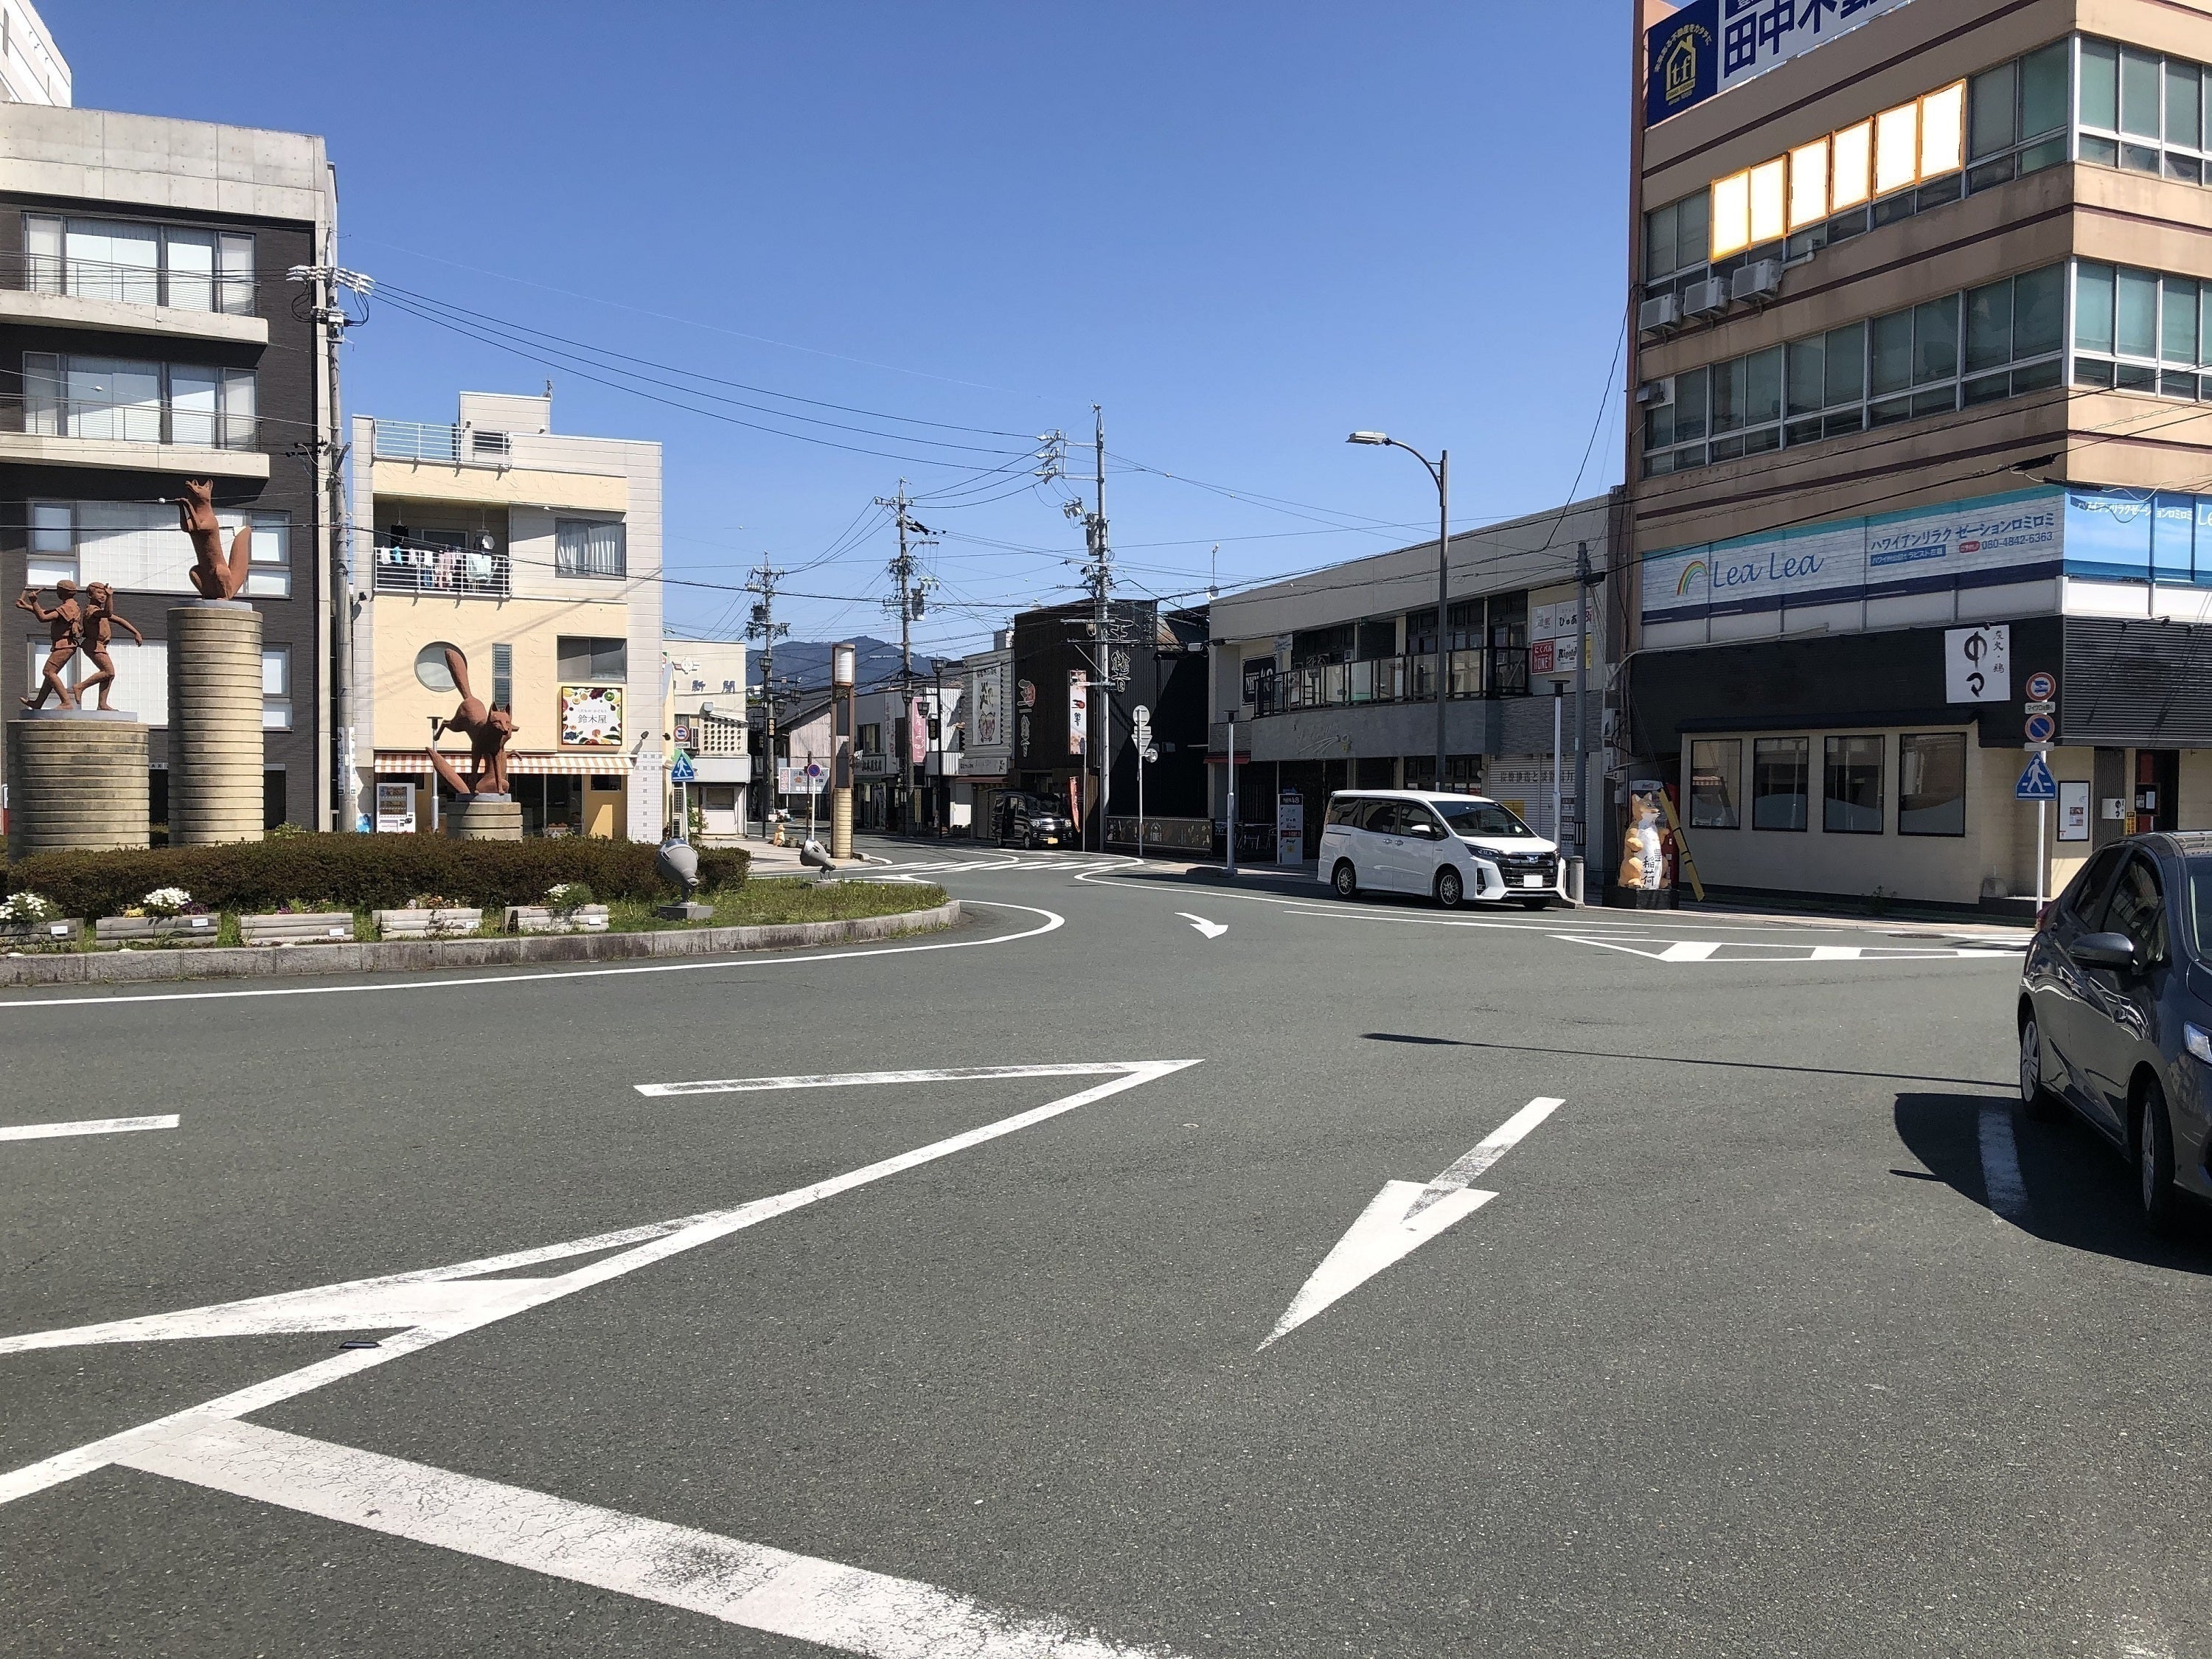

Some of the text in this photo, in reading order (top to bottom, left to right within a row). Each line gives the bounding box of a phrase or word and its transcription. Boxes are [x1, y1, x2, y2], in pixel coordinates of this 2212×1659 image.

[1713, 552, 1825, 588] Lea Lea
[577, 714, 608, 724] 鈴木屋
[1642, 855, 1655, 886] 稲荷
